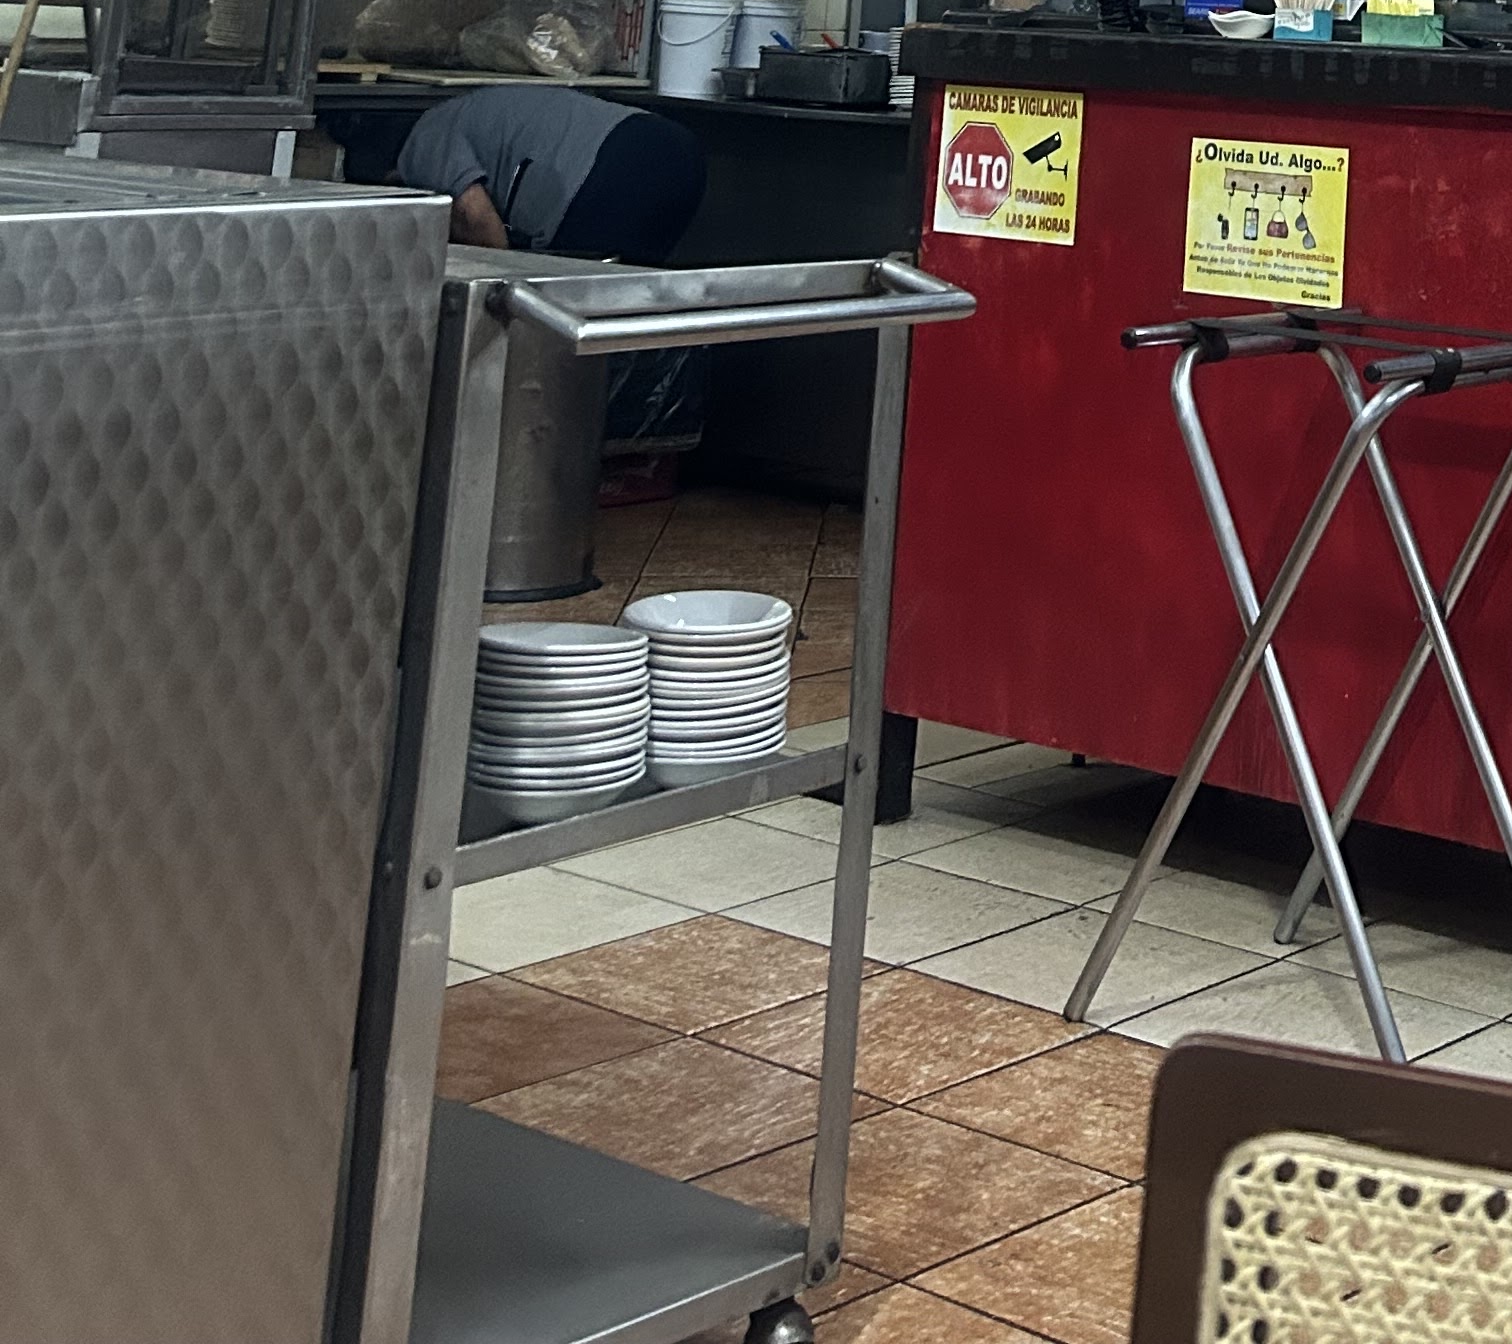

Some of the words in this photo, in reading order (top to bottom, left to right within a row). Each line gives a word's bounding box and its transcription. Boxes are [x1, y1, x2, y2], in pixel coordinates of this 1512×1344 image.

[949, 91, 999, 113] CAMARAS
[1001, 96, 1016, 114] DE
[1019, 97, 1078, 119] VIGILANCIA
[1195, 142, 1254, 163] ¿Olvida
[1259, 150, 1284, 167] Ud.
[1288, 153, 1345, 172] Algo...?
[948, 152, 1008, 190] ALTO
[1015, 188, 1065, 207] GRABANDO
[1006, 212, 1023, 229] LAS
[1025, 215, 1037, 229] 24
[1040, 216, 1070, 233] HORAS
[1227, 243, 1255, 255] Revise
[1258, 248, 1274, 256] sus
[1276, 247, 1336, 263] Pertenencias
[1196, 265, 1243, 278] Responsables
[1244, 270, 1252, 279] de
[1268, 275, 1294, 284] Objetos
[1301, 290, 1331, 302] Gracias
